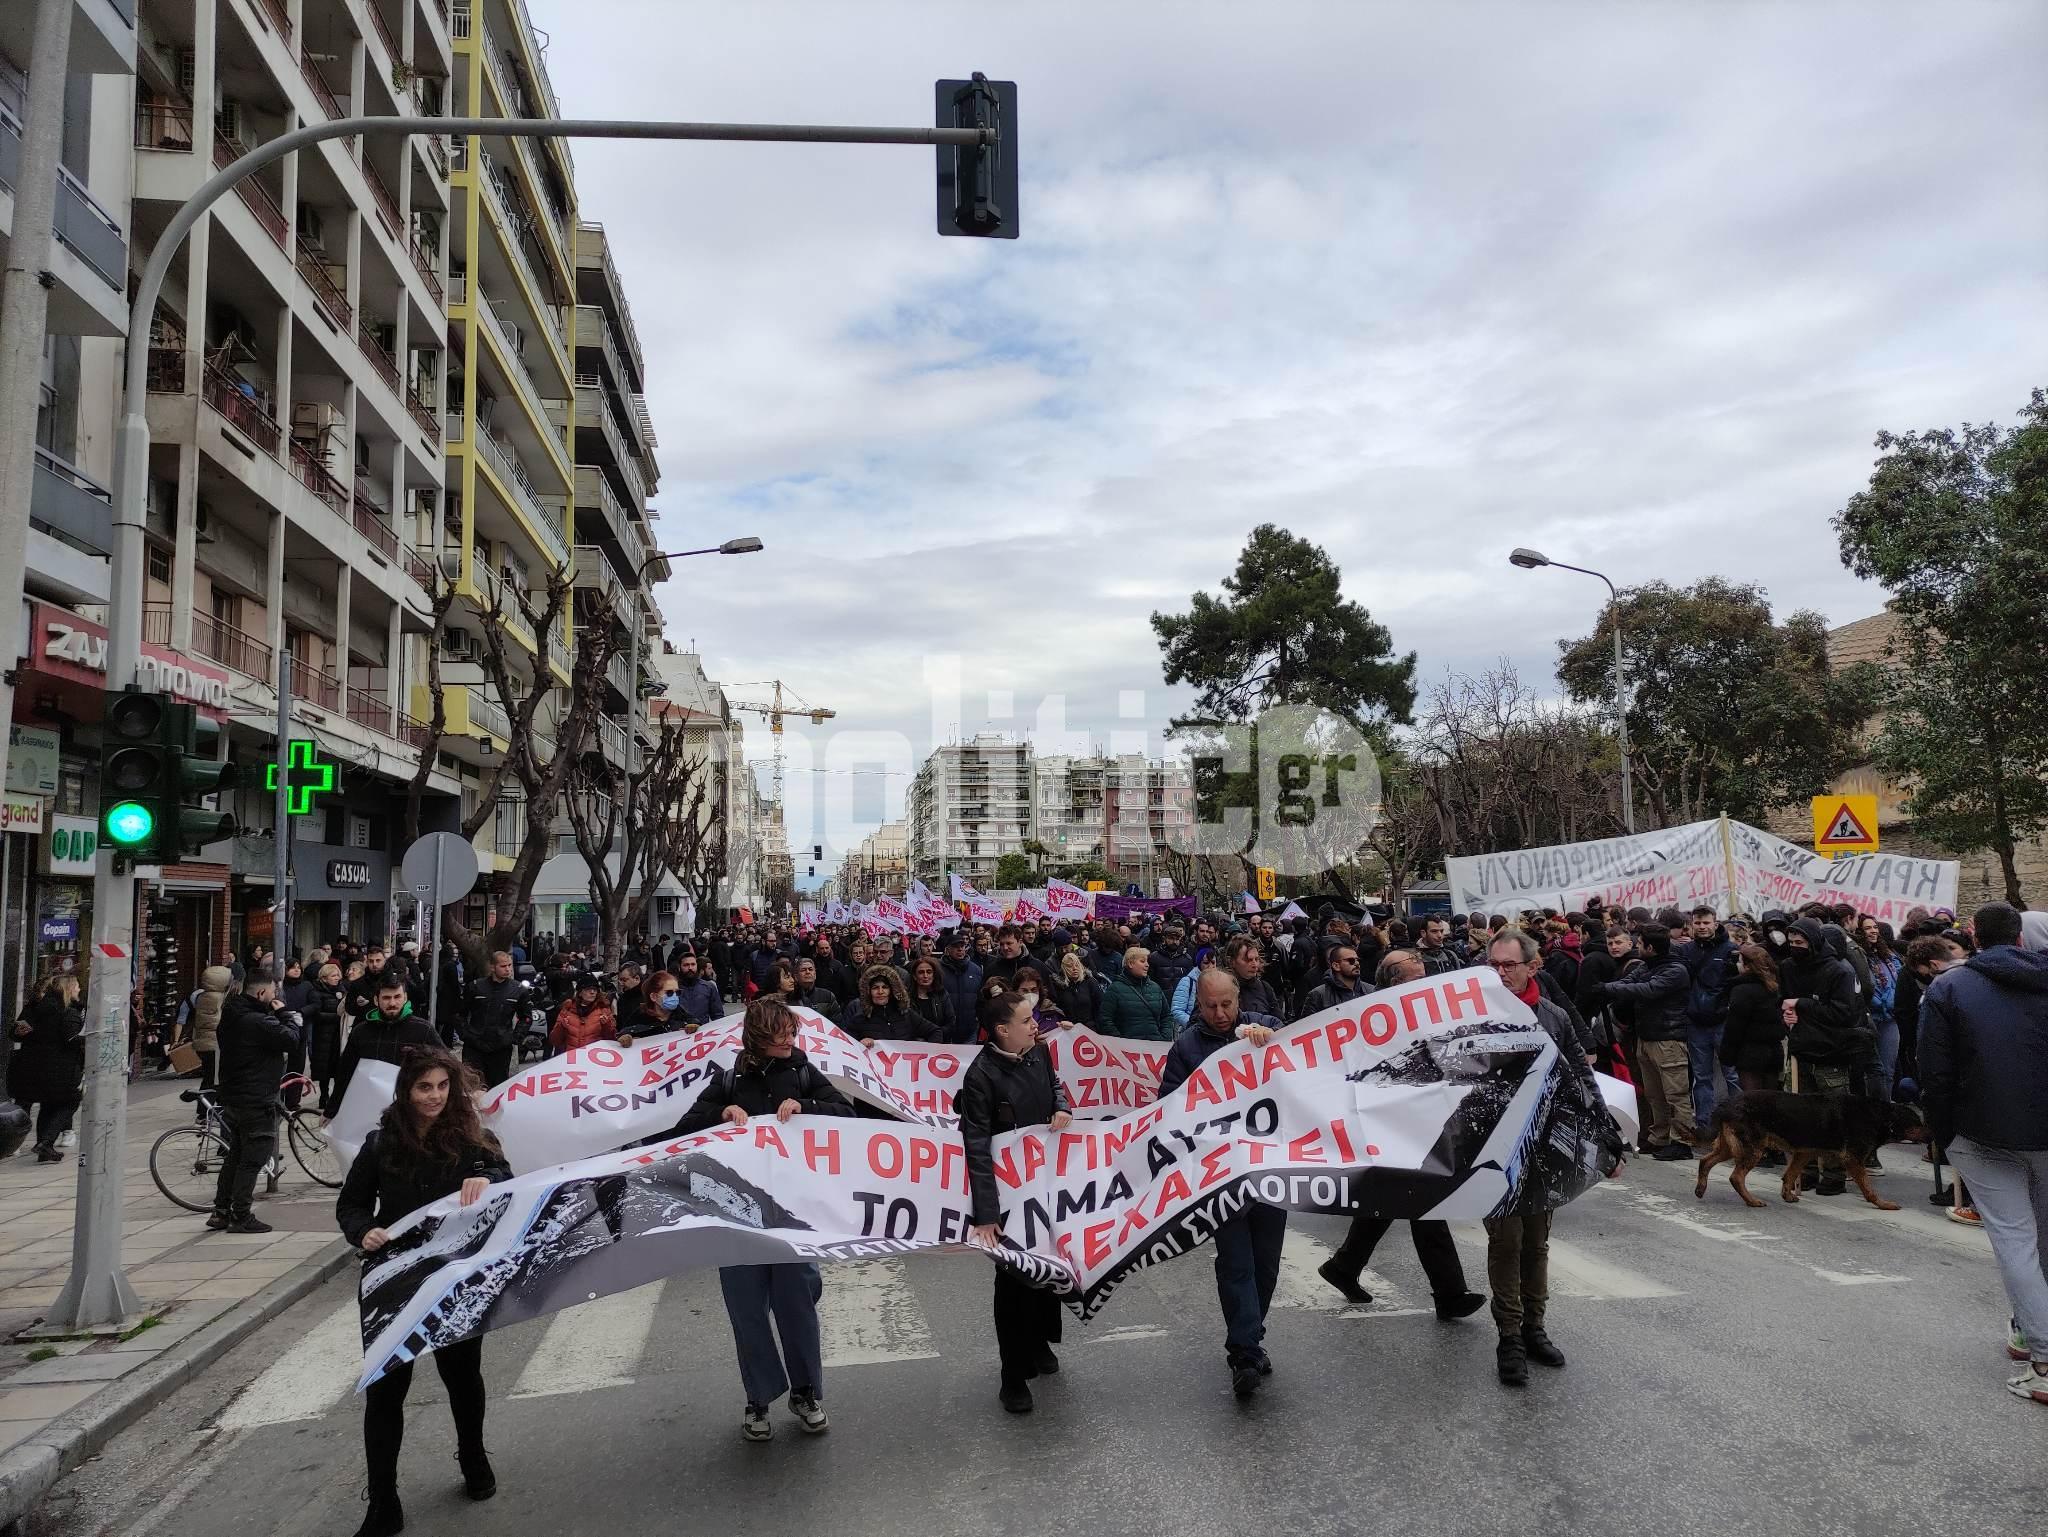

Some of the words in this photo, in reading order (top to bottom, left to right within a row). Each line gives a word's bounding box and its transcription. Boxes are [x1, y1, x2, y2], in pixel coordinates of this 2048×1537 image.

[1, 801, 39, 828] grand
[333, 863, 371, 884] CASUAL
[43, 922, 71, 937] Gopain
[566, 1046, 624, 1068] ΤΟ
[864, 1048, 960, 1083] ΥΤΟ
[1072, 1034, 1128, 1071] ΘΑ
[803, 1129, 841, 1175] Η
[1185, 977, 1489, 1113] ΑΝΑΤΡΟΠΗ
[571, 1059, 725, 1119] ΚΟΝΤΡΑ
[852, 1191, 919, 1240] ΤΟ
[1180, 1175, 1360, 1247] ΣΥΛΛΟΓΟΙ.
